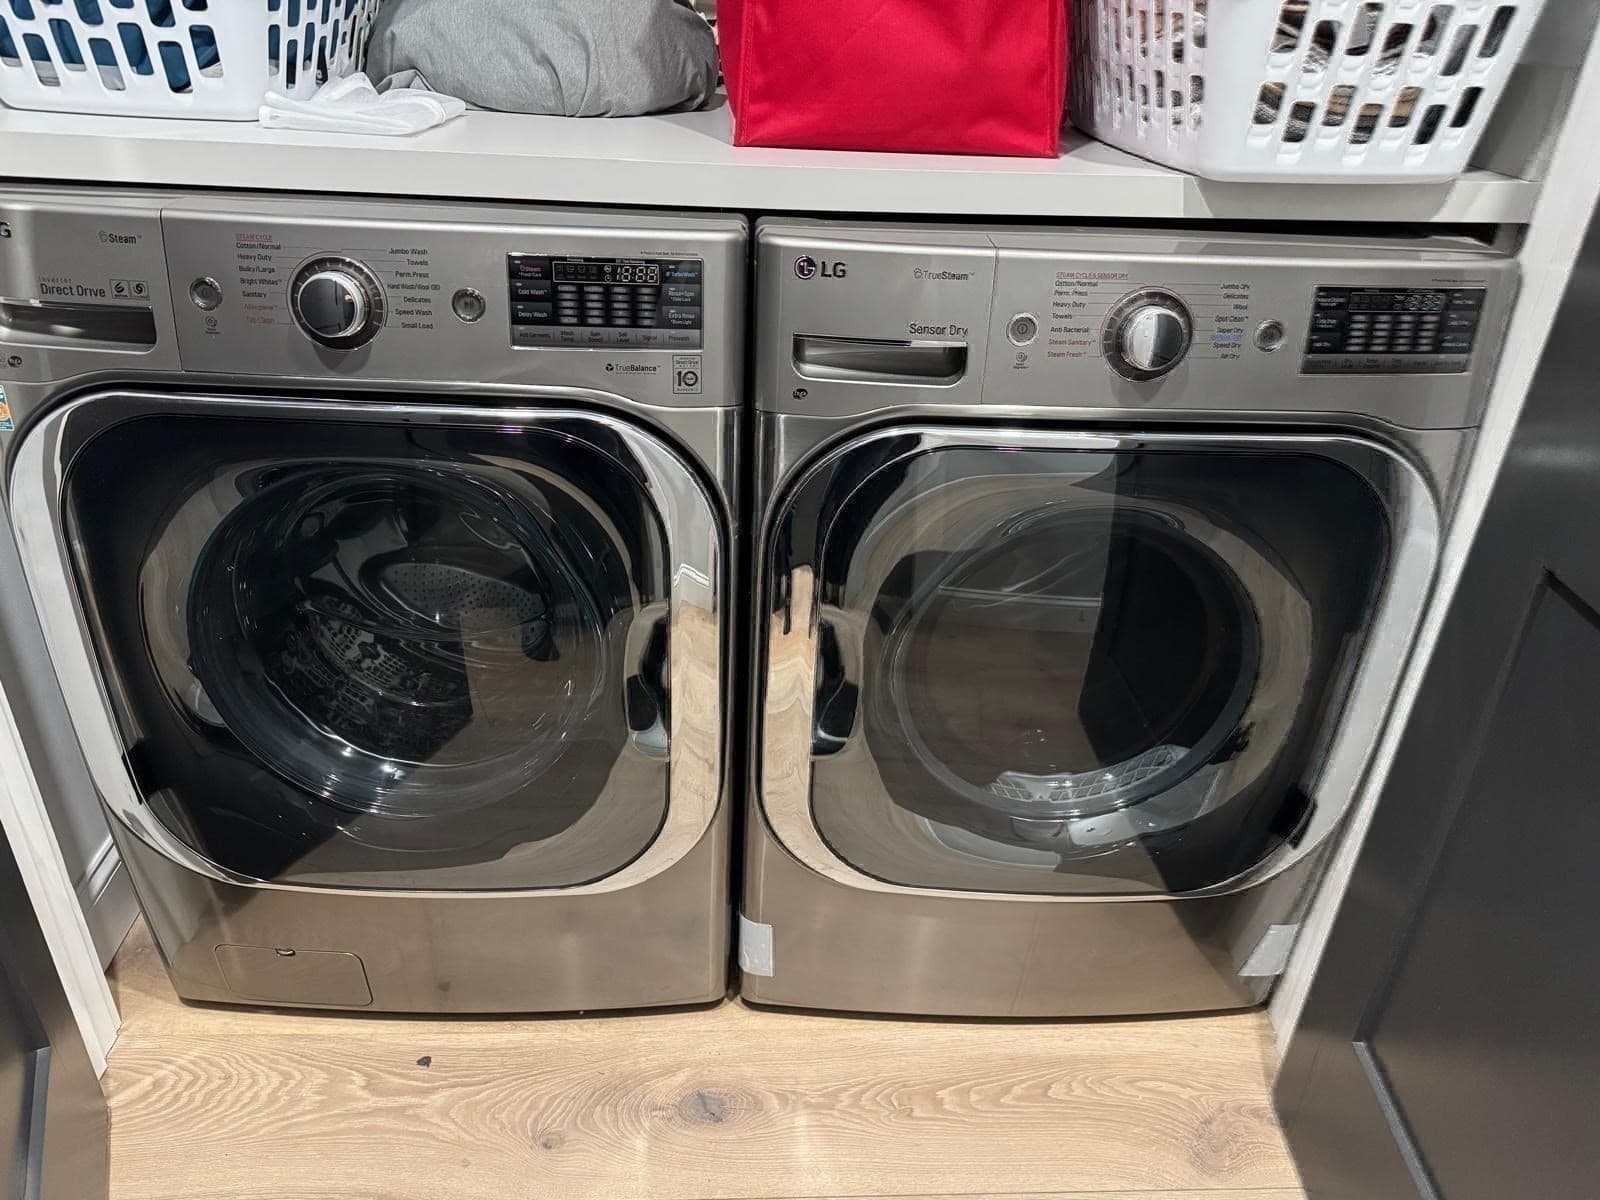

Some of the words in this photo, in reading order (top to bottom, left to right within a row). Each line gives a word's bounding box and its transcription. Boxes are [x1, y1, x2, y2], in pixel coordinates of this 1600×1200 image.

[237, 253, 256, 261] Heavy
[257, 253, 272, 261] Duty
[820, 261, 847, 278] LG
[40, 283, 74, 297] Direct
[76, 285, 106, 298] Drive
[909, 323, 947, 335] Sensor
[949, 325, 968, 338] Dry
